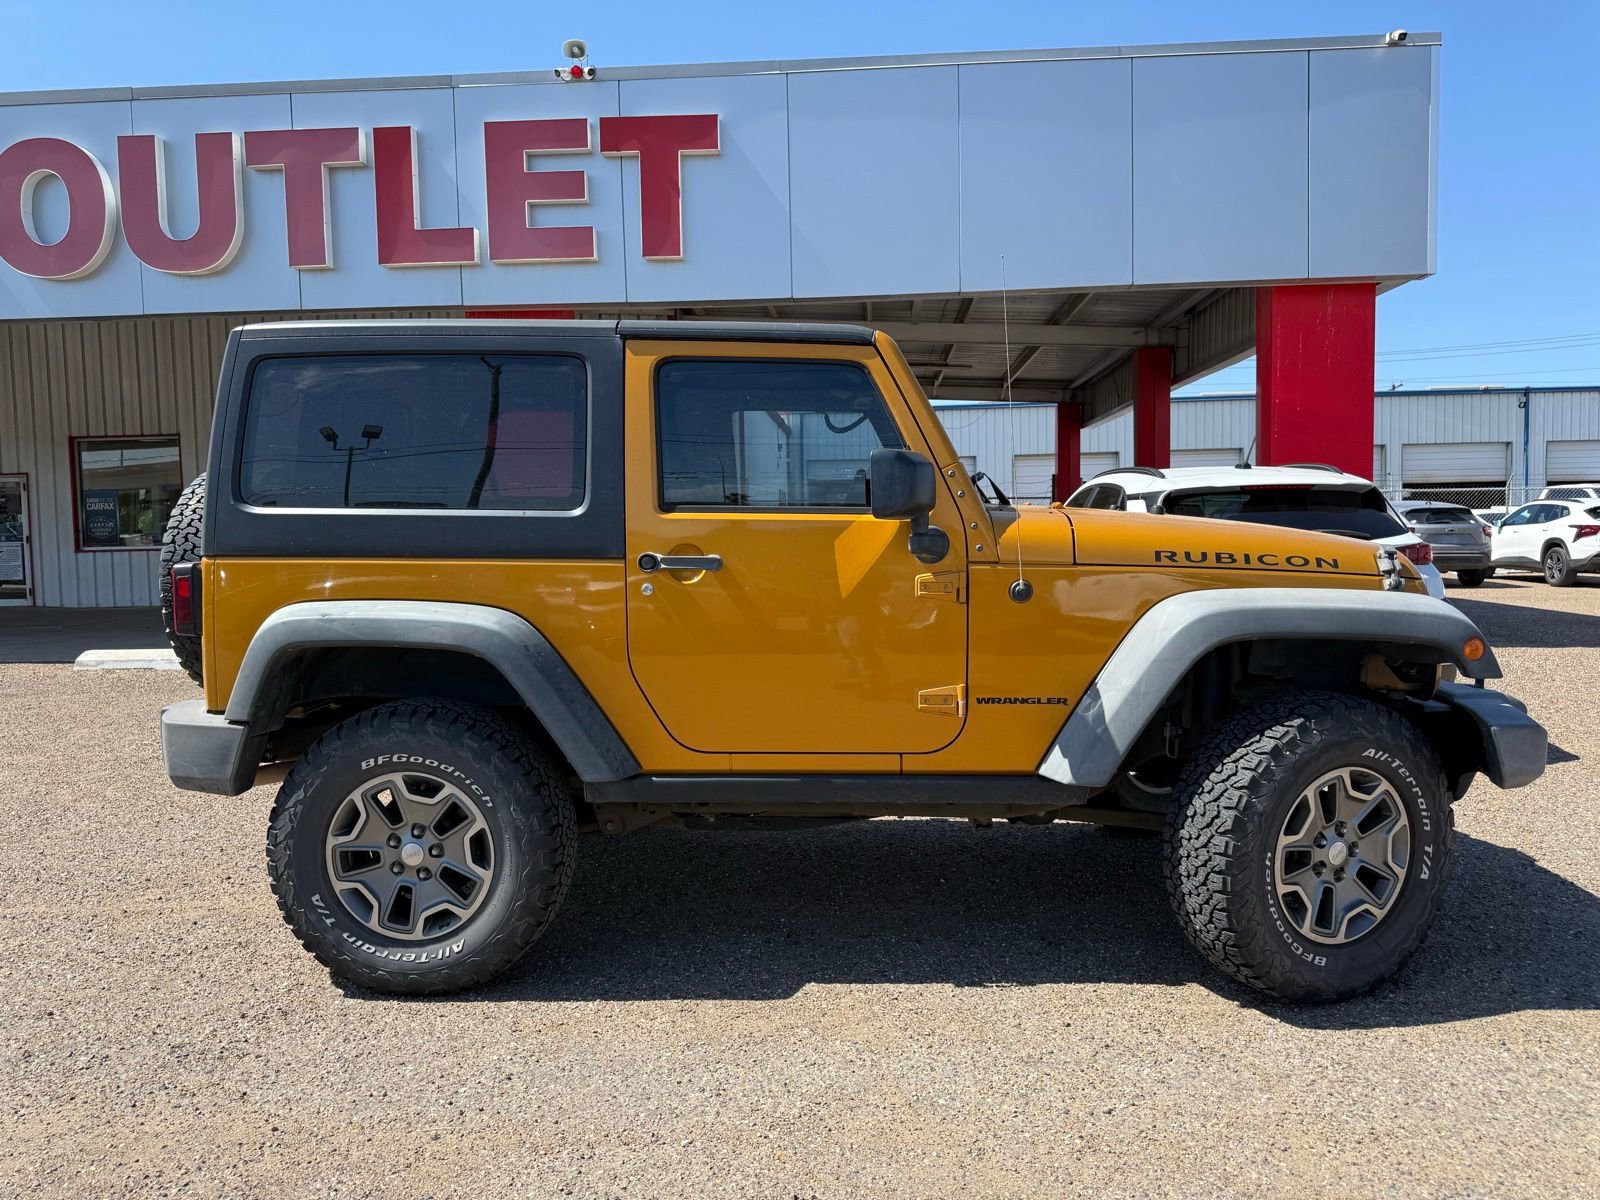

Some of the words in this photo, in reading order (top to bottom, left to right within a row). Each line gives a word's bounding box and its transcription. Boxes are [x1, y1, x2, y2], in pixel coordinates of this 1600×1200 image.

[0, 113, 722, 281] OUTLET
[86, 502, 114, 510] CARFAX
[1154, 550, 1340, 569] RUBICON
[975, 697, 1068, 705] WRANGLER
[361, 753, 493, 808] BFGoodrich
[1361, 748, 1432, 832] All-Terrain
[1420, 843, 1434, 881] T/A
[310, 893, 336, 927] T/A
[1265, 852, 1327, 966] BFGoodrich
[341, 931, 466, 963] All-Terrain
